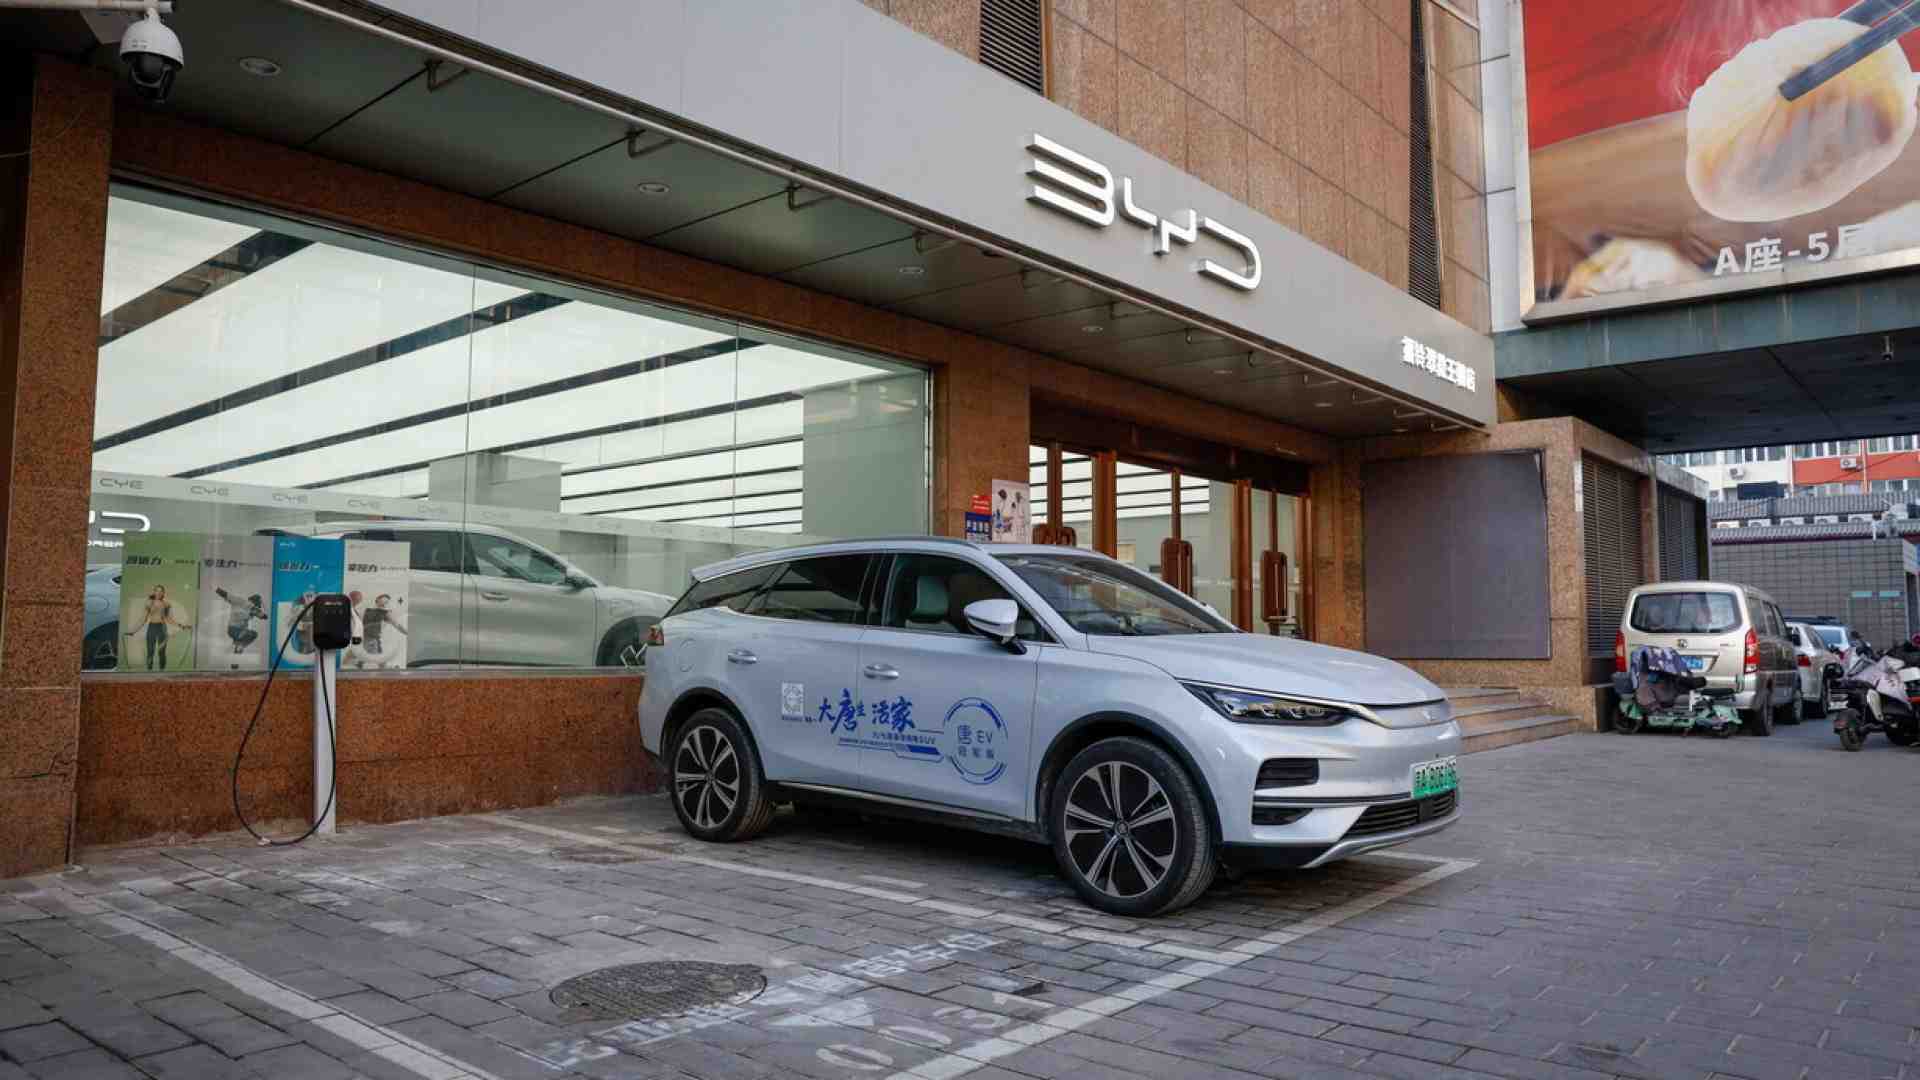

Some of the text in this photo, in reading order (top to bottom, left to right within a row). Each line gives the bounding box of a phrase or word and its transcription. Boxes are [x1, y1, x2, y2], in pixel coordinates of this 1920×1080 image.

[1027, 133, 1262, 290] BYD
[818, 688, 916, 734] 大唐生活家
